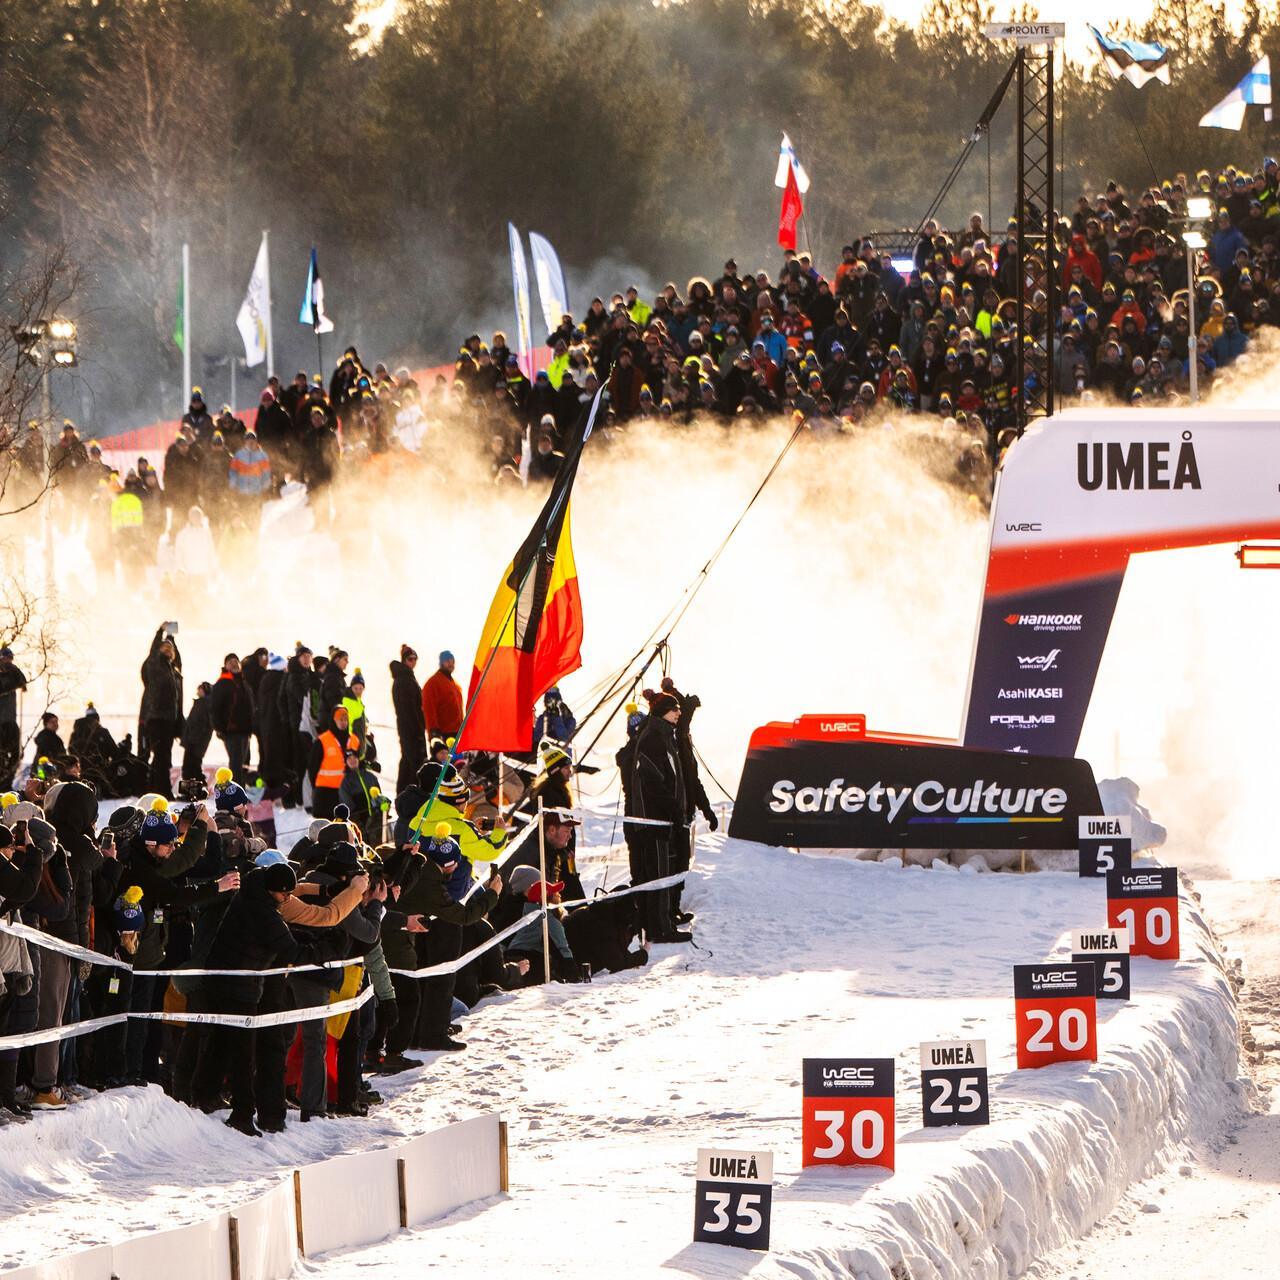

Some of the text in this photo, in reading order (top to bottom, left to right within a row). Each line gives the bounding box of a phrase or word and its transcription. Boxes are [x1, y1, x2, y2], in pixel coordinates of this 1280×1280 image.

[1010, 26, 1050, 35] PROLYTE
[1077, 430, 1202, 491] UMEÅ
[1006, 523, 1042, 532] WRC
[821, 721, 861, 732] WRC
[1088, 819, 1122, 836] UMEÅ
[1096, 845, 1115, 874] 5
[1122, 875, 1162, 885] WRC
[1117, 907, 1171, 946] 10
[1081, 932, 1118, 950] UMEÅ
[1032, 971, 1077, 983] WRC
[1102, 961, 1124, 993] 5
[1025, 1008, 1088, 1053] 20
[931, 1043, 975, 1066] UMEÅ
[822, 1067, 875, 1079] WRC
[929, 1077, 982, 1114] 25
[813, 1110, 885, 1159] 30
[709, 1155, 759, 1180] UMEÅ
[702, 1191, 763, 1235] 35
